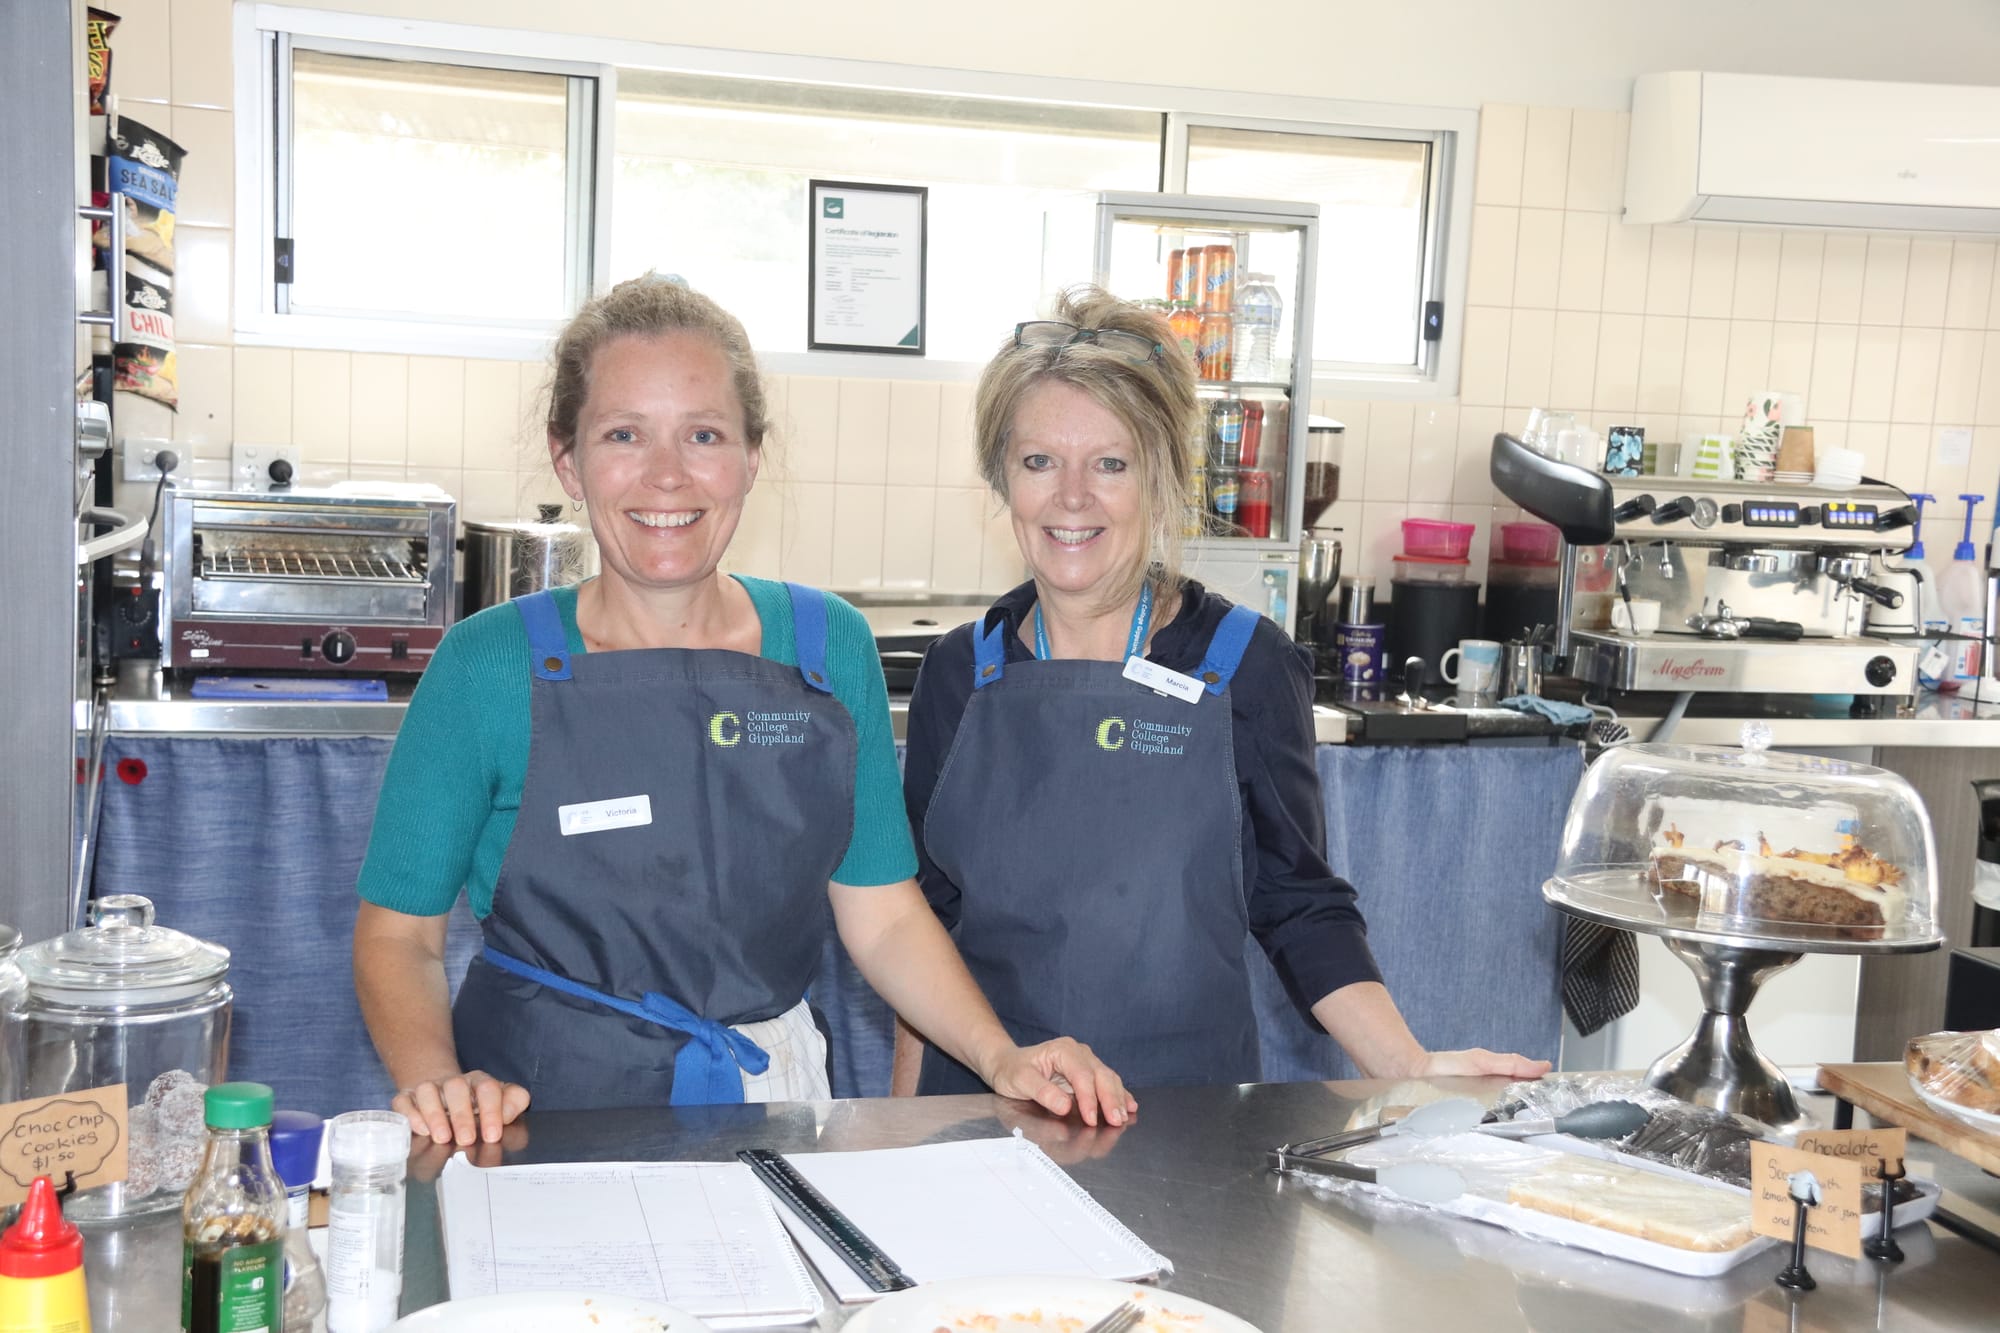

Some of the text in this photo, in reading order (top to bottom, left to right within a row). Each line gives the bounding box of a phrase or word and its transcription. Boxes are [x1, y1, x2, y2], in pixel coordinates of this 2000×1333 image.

[121, 169, 147, 190] SEA
[130, 311, 170, 339] CHIL
[1166, 677, 1189, 692] Marcia
[747, 710, 811, 723] Community
[708, 711, 741, 748] C
[747, 722, 788, 734] College
[1095, 716, 1126, 751] C
[1133, 718, 1192, 737] Community
[748, 733, 805, 746] Gippsland
[1131, 730, 1169, 744] College
[1130, 740, 1183, 755] Gippsland
[605, 806, 637, 818] Victoria
[67, 1115, 104, 1128] Chip
[21, 1131, 98, 1156] Cookies
[1801, 1136, 1880, 1157] Chocolate
